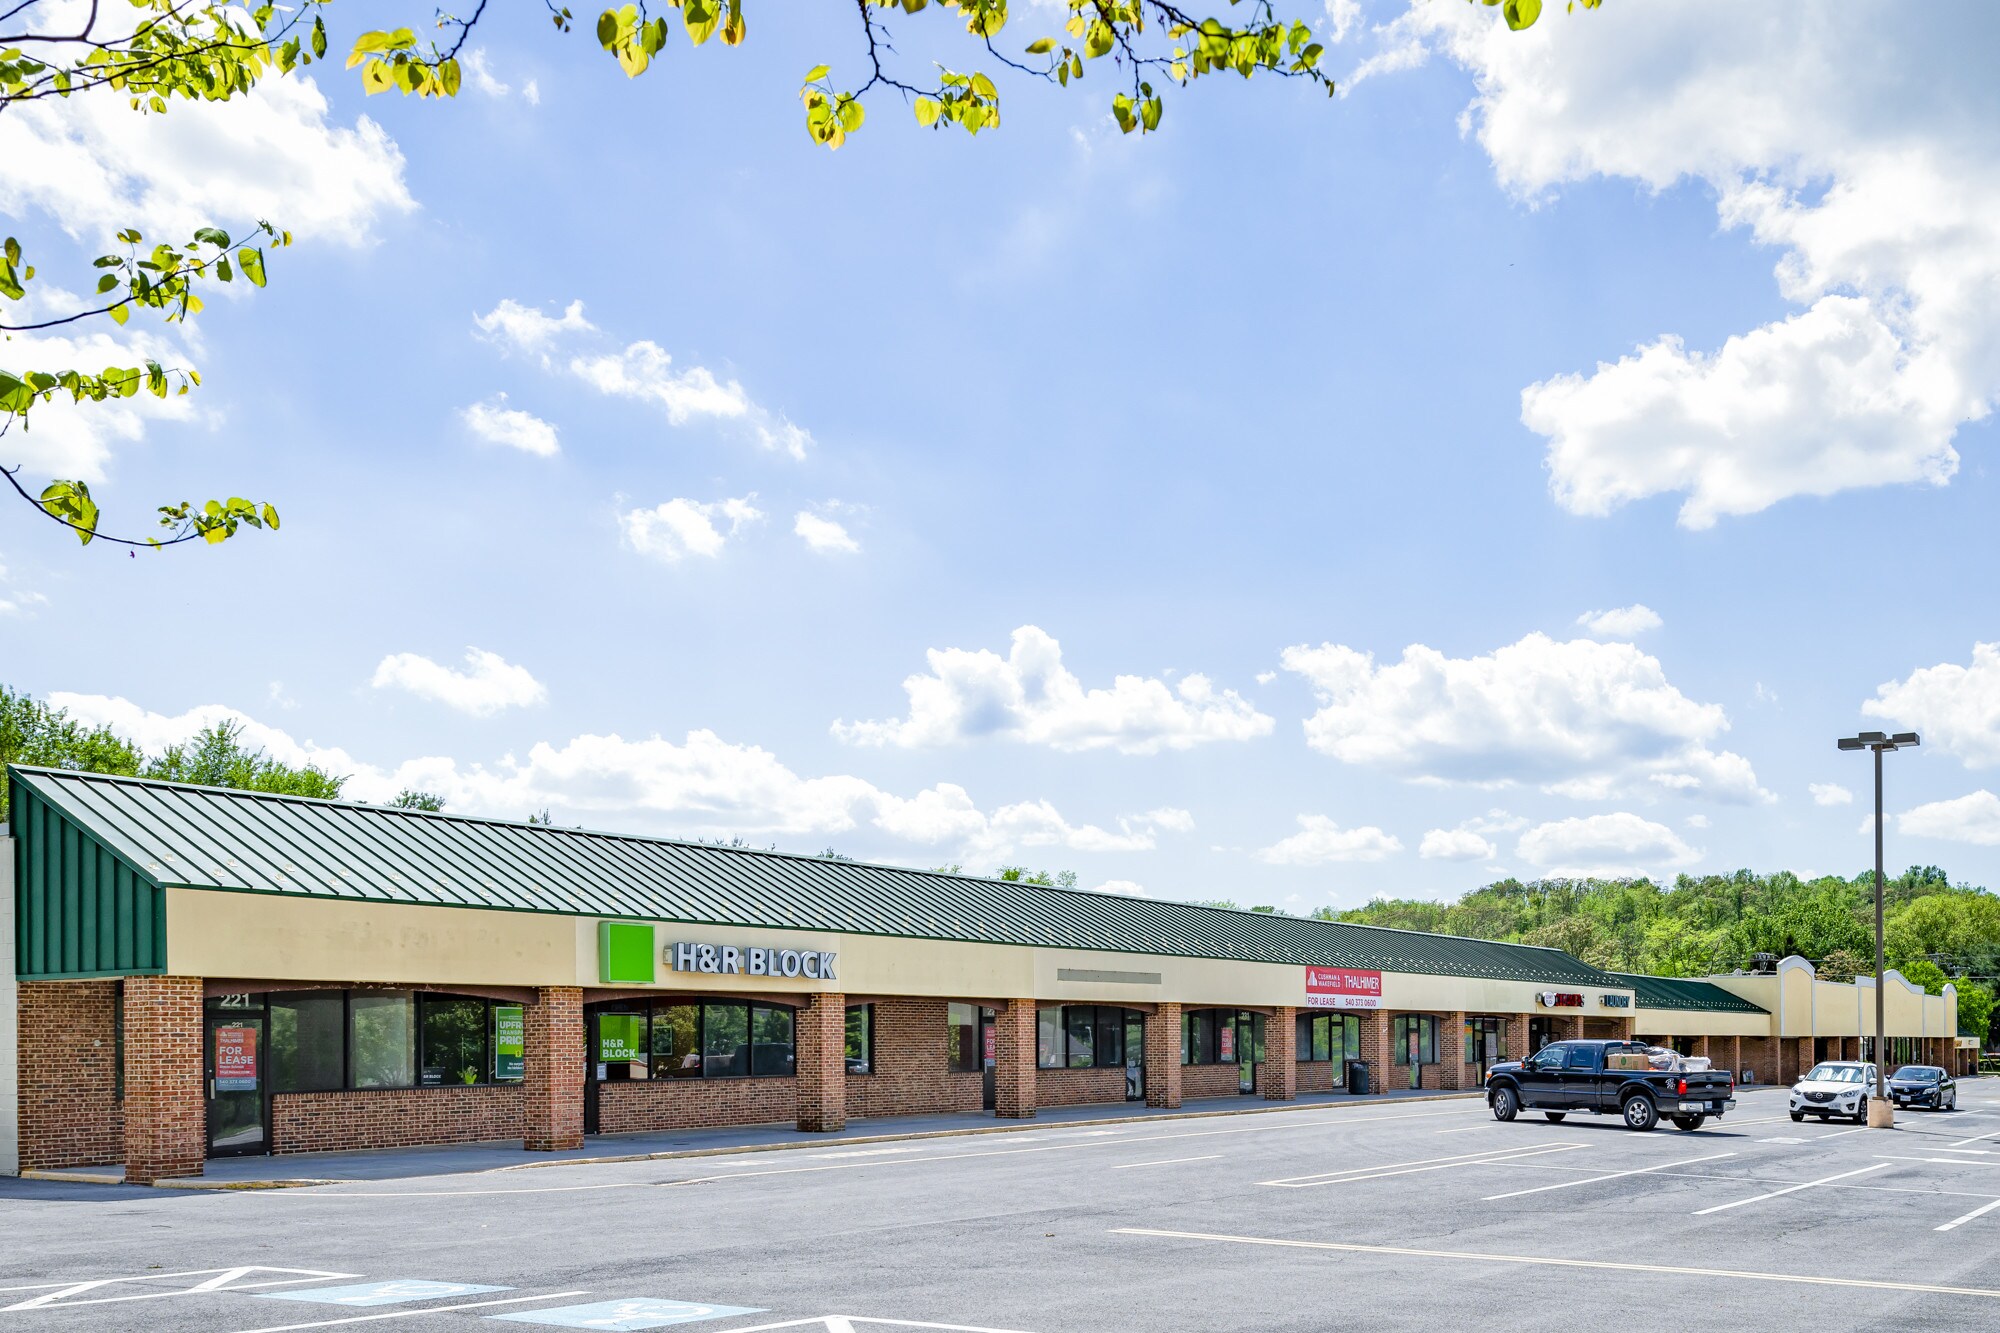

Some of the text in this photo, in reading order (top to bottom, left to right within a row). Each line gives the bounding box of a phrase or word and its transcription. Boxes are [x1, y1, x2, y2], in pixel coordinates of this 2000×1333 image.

[673, 942, 836, 980] H&R BLOCK
[1318, 980, 1340, 988] WAKEFIELD
[1344, 975, 1379, 990] THALHIMER
[220, 993, 250, 1007] 221
[1308, 996, 1318, 1006] FOR
[1320, 997, 1335, 1006] LEASE
[1345, 998, 1354, 1006] 540
[500, 1021, 523, 1029] UPFR
[602, 1039, 624, 1048] H&R
[219, 1046, 242, 1055] FOR
[602, 1049, 636, 1058] BLOCK
[219, 1056, 254, 1065] LEASE
